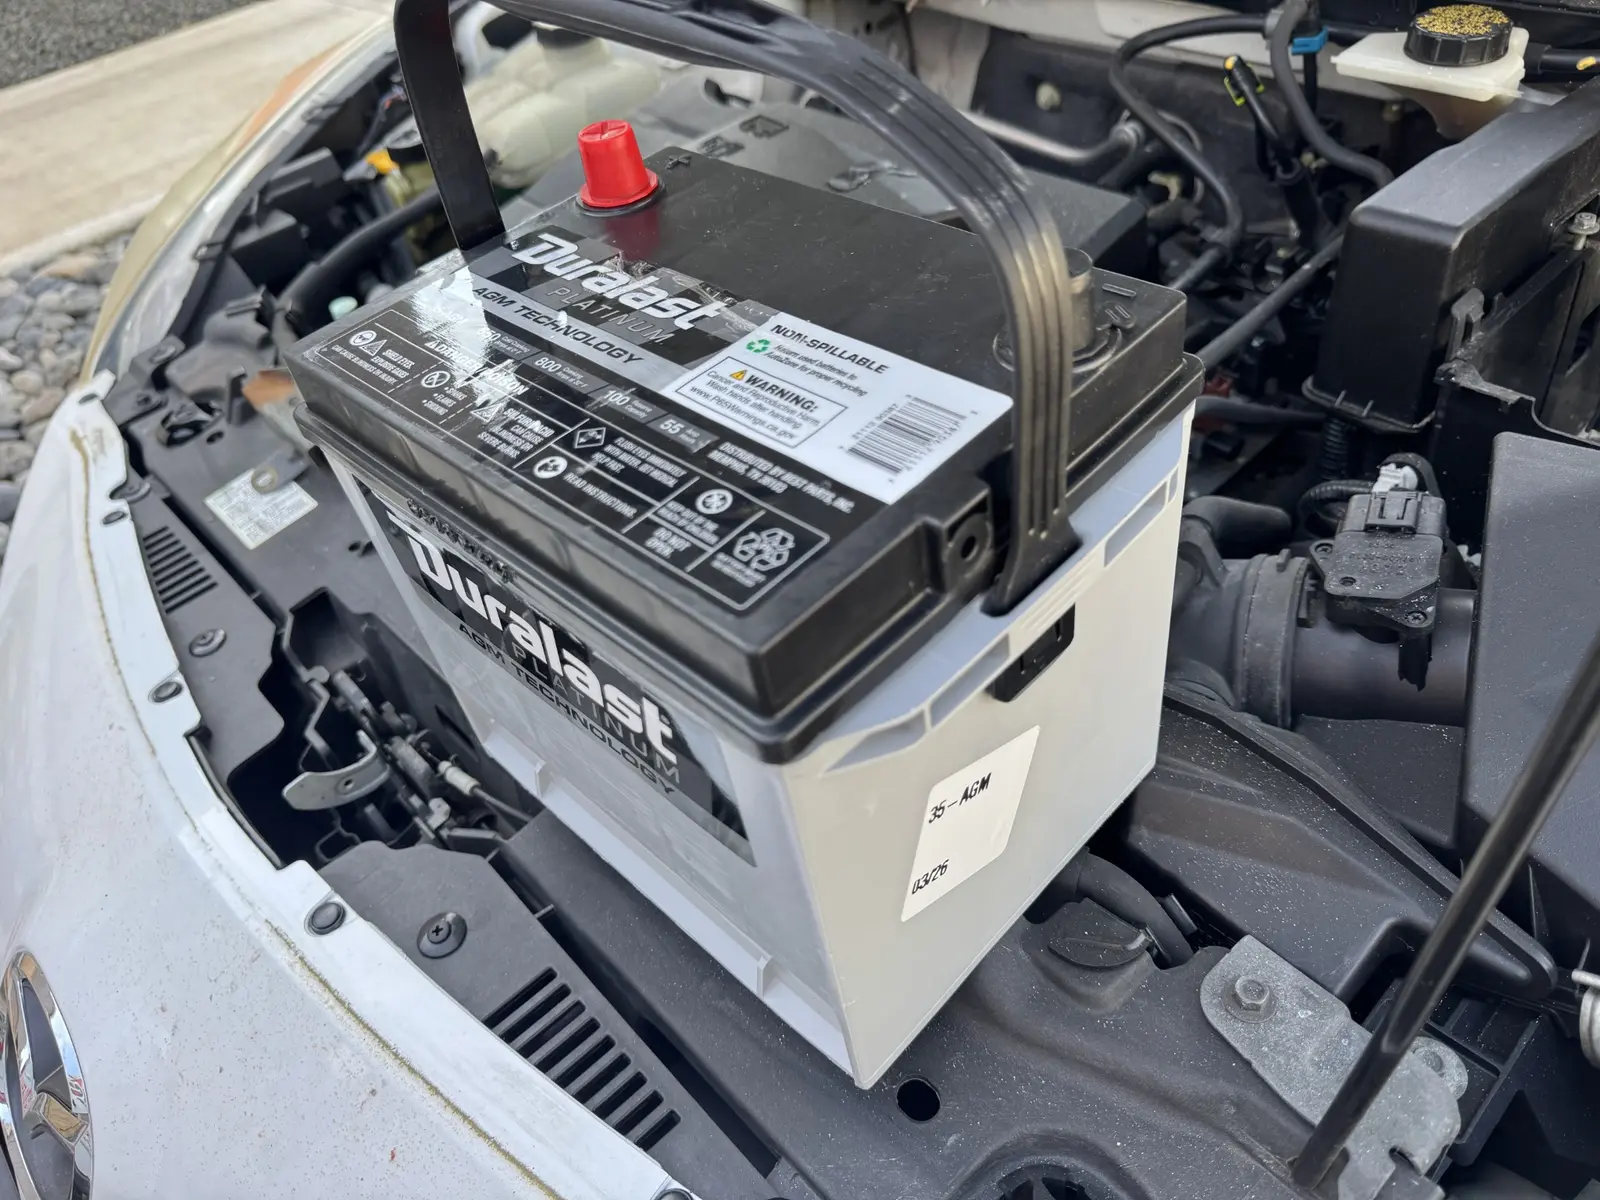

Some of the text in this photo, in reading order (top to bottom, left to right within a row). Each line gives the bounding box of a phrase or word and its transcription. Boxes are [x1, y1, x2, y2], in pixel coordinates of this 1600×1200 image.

[511, 233, 728, 331] Duralast
[472, 286, 645, 364] AGM TECHNOLOGY
[548, 286, 675, 345] PLATINUM
[533, 355, 563, 373] 800
[762, 350, 801, 368] AutoZone
[805, 369, 835, 383] proper
[767, 324, 892, 374] NON-SPILLABLE
[796, 353, 819, 365] used
[814, 360, 850, 377] batteries
[600, 388, 632, 406] 100
[703, 379, 731, 393] Wash
[725, 389, 754, 404] hands
[748, 400, 772, 413] after
[704, 370, 737, 386] Cancer
[730, 381, 751, 393] and
[744, 388, 801, 415] Reproductive
[741, 374, 823, 412] WARNING:
[501, 407, 539, 428] SULFURI
[657, 417, 686, 435] 55
[719, 442, 774, 472] DISTRIBUTED
[560, 471, 589, 489] READ
[386, 510, 676, 765] Duralast
[459, 623, 675, 794] AGM TECHNOLOGY
[513, 640, 680, 784] PLATINUM
[912, 859, 949, 894] 03/26
